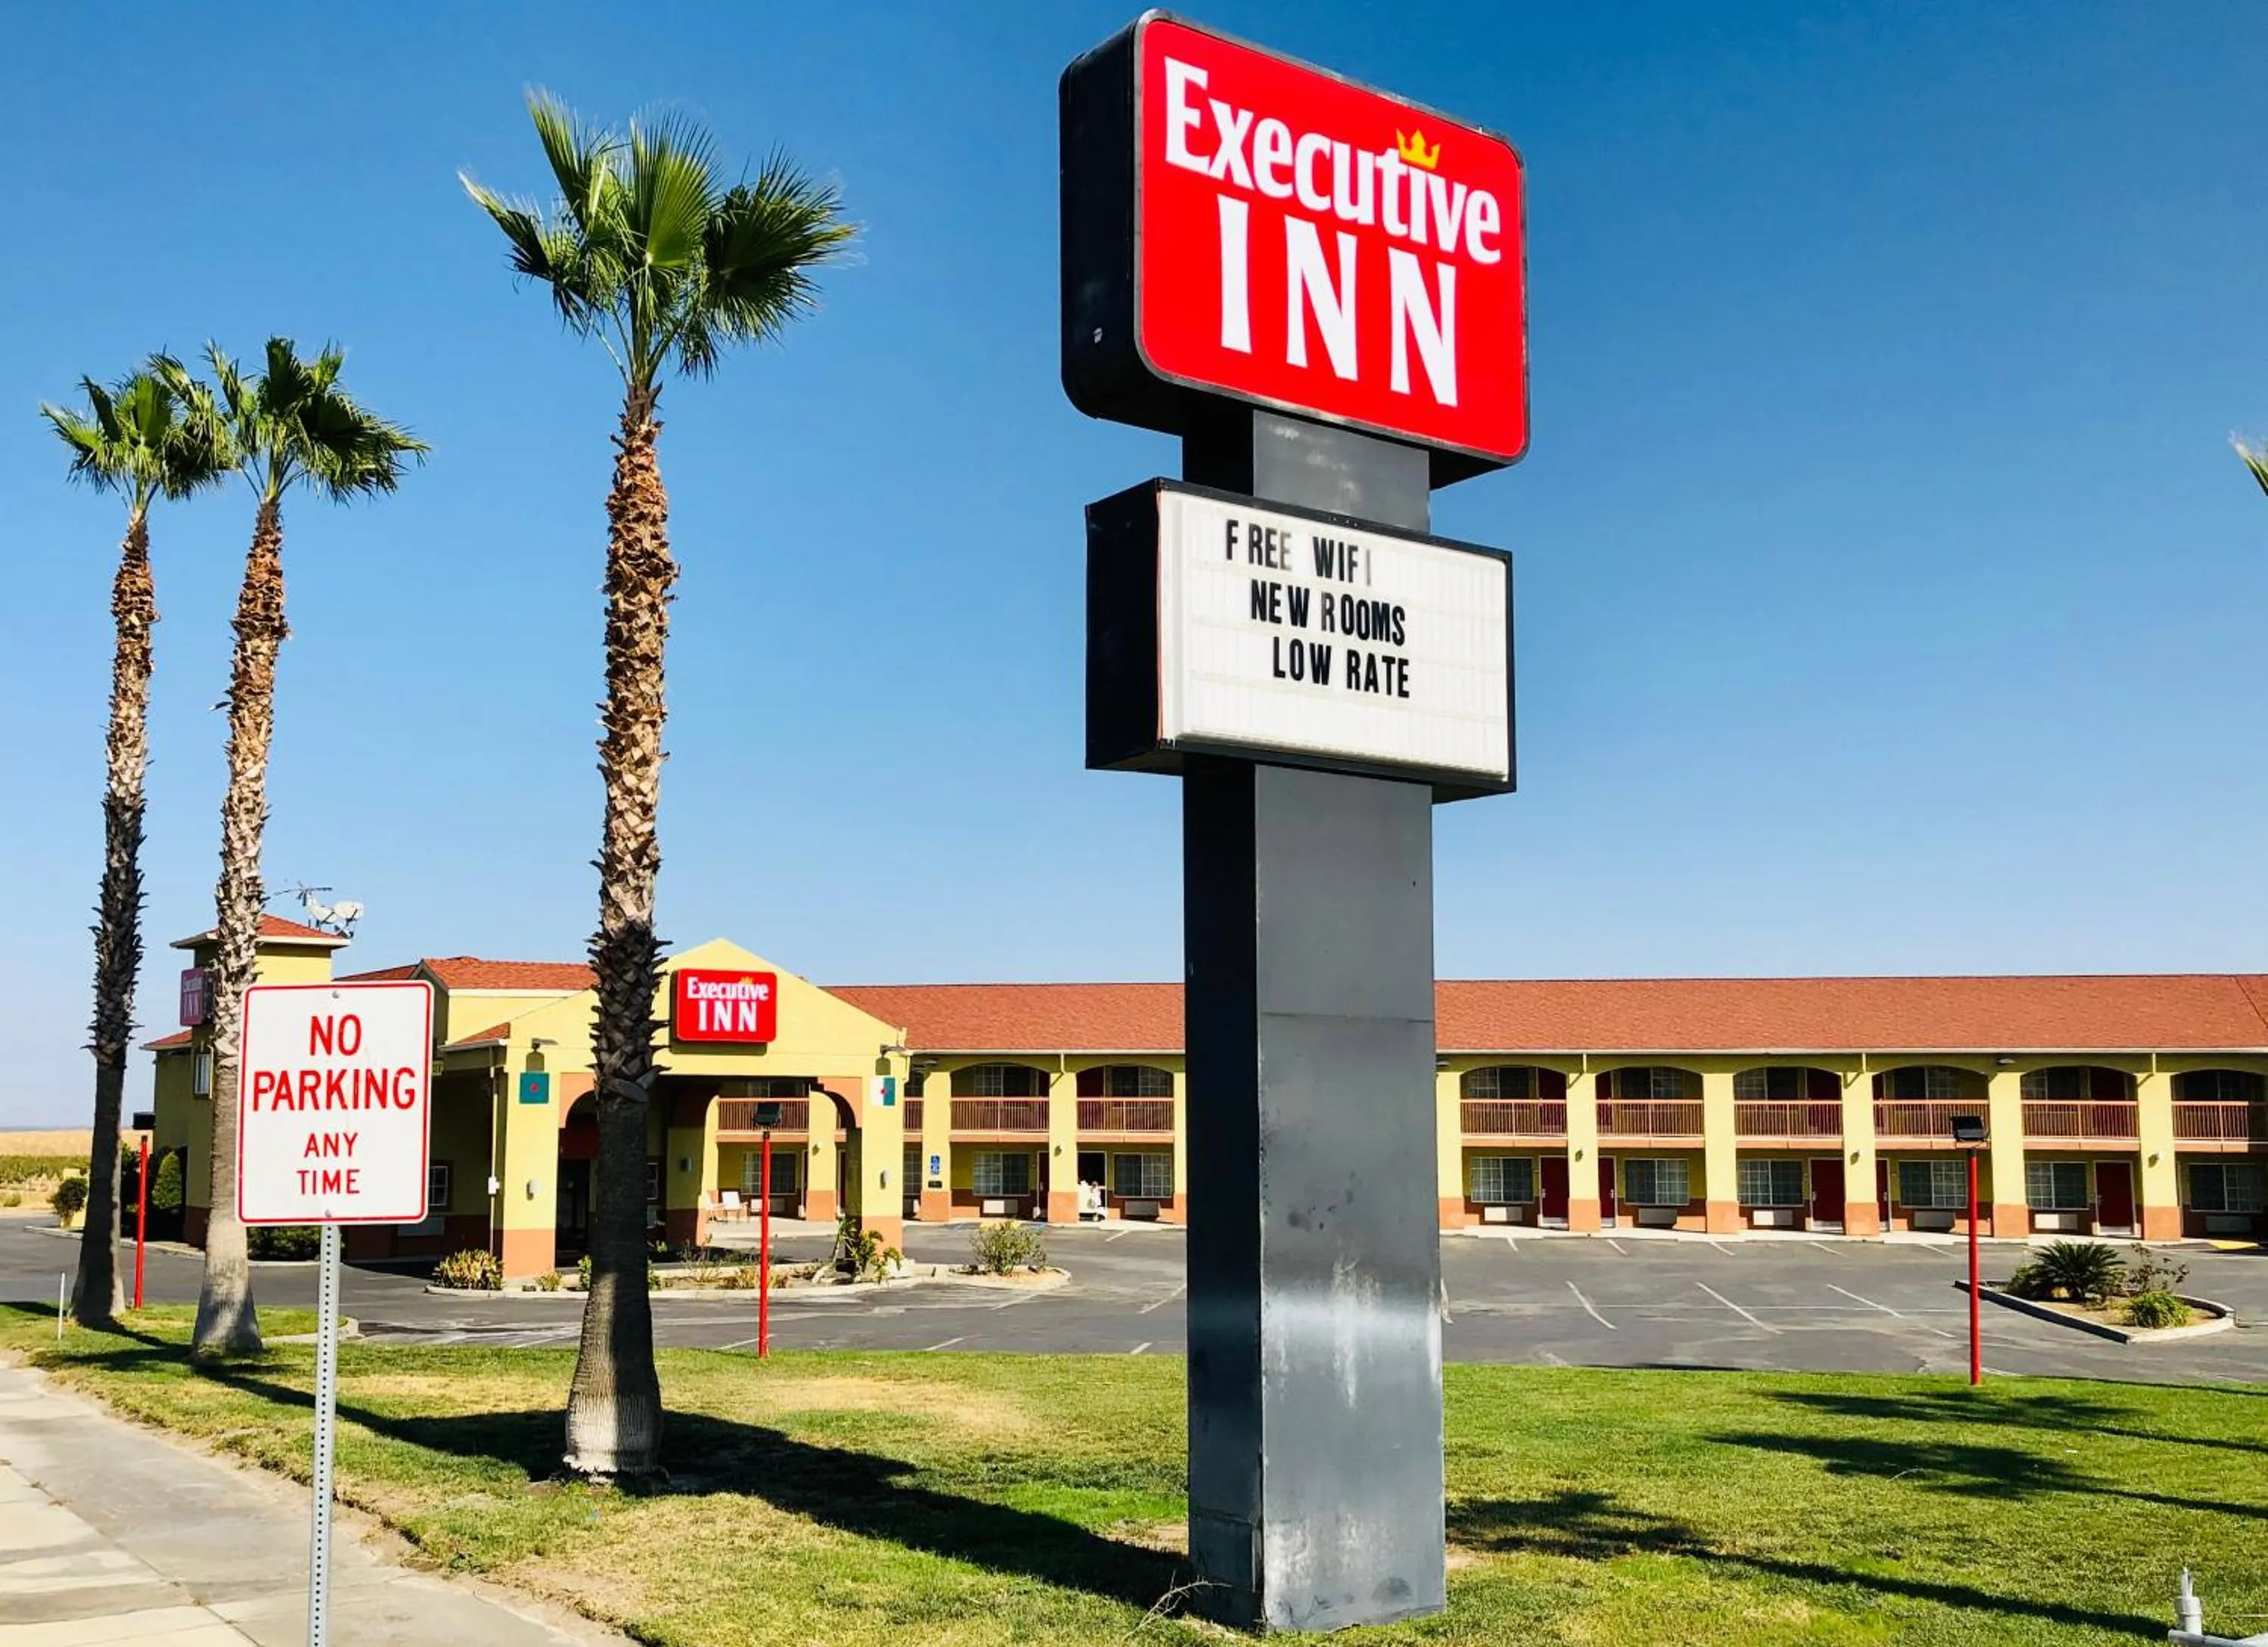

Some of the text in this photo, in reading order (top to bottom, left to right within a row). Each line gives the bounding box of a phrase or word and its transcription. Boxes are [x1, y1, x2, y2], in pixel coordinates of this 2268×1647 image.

[1164, 57, 1501, 264] Executive
[1217, 194, 1458, 407] INN
[1226, 520, 1372, 587] FREE WIFI
[1251, 580, 1406, 647] NEW ROOMS
[1272, 636, 1410, 698] LOW RATE
[687, 976, 769, 1000] Executive
[309, 1014, 362, 1056] NO
[698, 1000, 757, 1032] INN
[252, 1067, 415, 1112] PARKING
[304, 1133, 358, 1158] ANY
[296, 1169, 361, 1195] TIME
